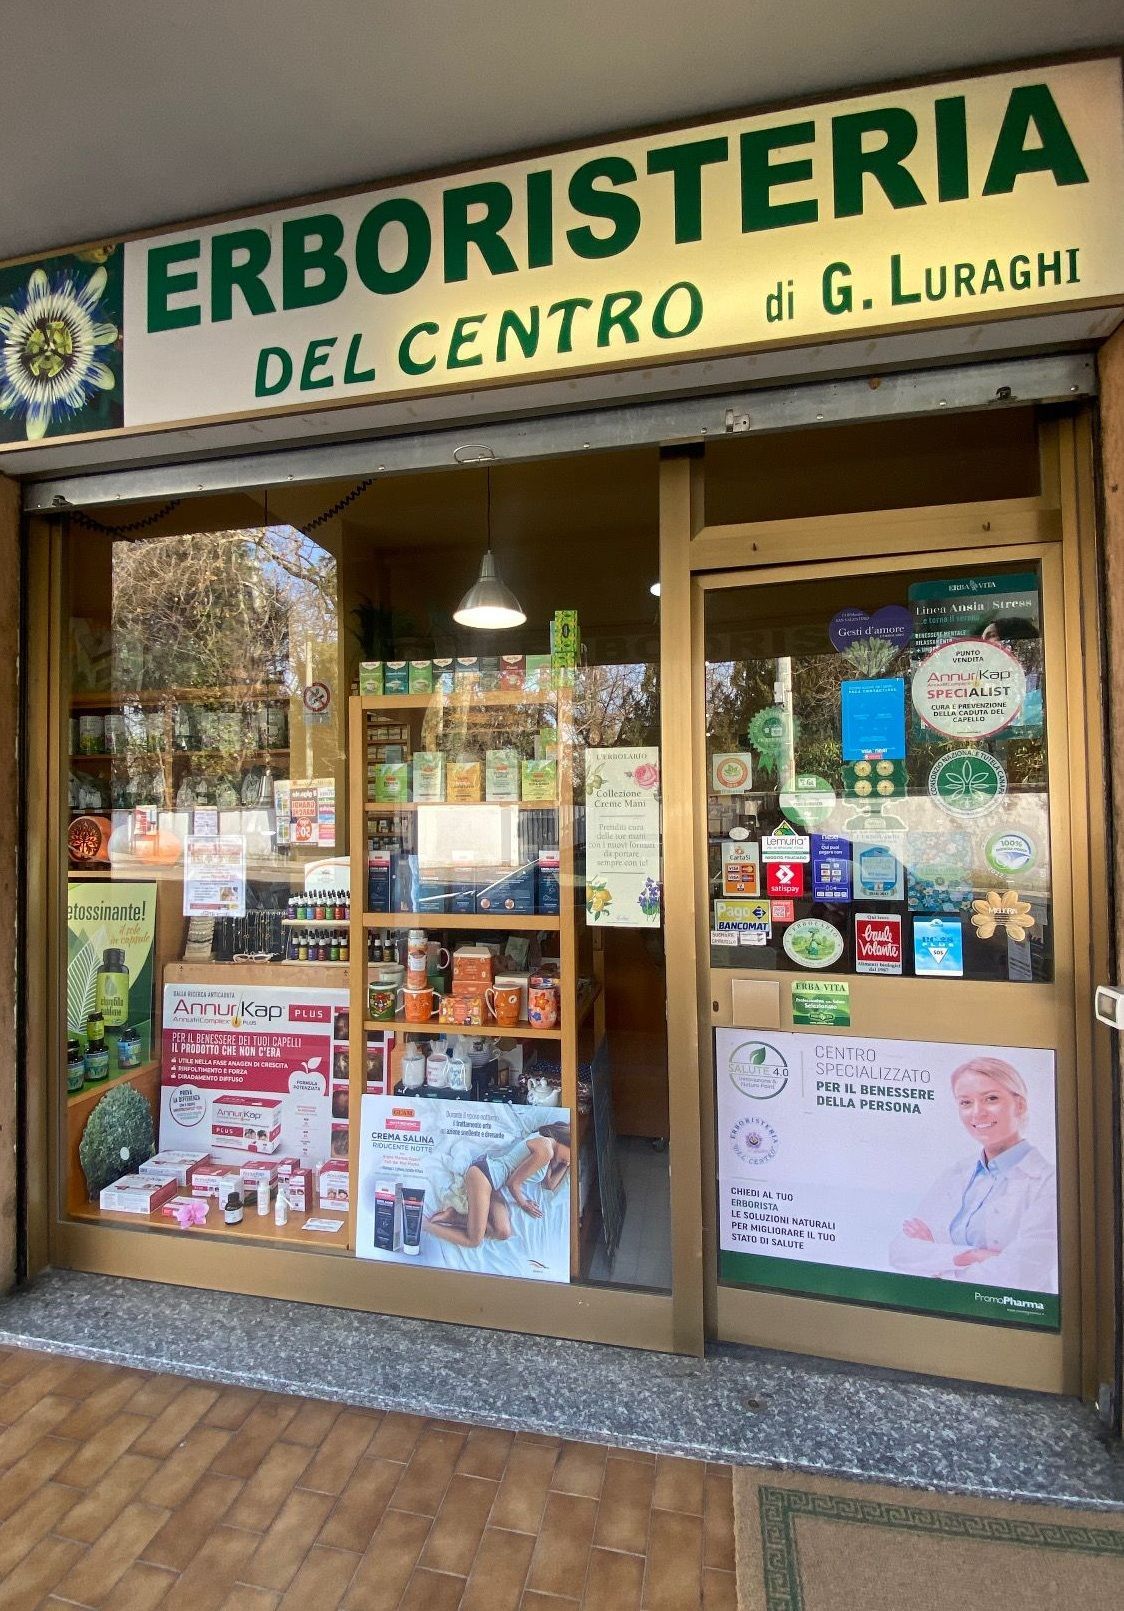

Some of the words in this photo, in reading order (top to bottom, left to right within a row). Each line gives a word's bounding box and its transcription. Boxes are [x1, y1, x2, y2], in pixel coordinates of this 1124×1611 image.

[147, 84, 1088, 332] ERBORISTERIA
[766, 283, 795, 323] di
[821, 262, 873, 316] G.
[891, 247, 1081, 307] LURAGHI
[256, 331, 375, 397] DEL
[399, 282, 703, 379] CENTRO
[916, 606, 946, 616] Linea
[950, 601, 984, 613] Ansia
[992, 599, 1032, 610] Stress
[838, 627, 862, 636] Gesti
[865, 626, 904, 635] d'amore
[928, 669, 1011, 682] AnnurKap
[927, 686, 1011, 699] SPECIALIST
[596, 790, 642, 798] Collezione
[594, 799, 622, 807] Creme
[625, 799, 646, 807] Mani
[766, 836, 804, 846] Lemuria
[770, 885, 799, 894] satispay
[717, 903, 750, 919] Pago
[718, 921, 768, 931] BANCOMAT
[858, 938, 900, 958] Volante
[796, 983, 820, 991] ERBA
[173, 998, 282, 1021] AnnurKap
[294, 1009, 323, 1018] PLUS
[172, 1032, 187, 1043] PER
[188, 1033, 194, 1043] IL
[196, 1033, 236, 1046] BENESSERE
[238, 1035, 251, 1046] DEI
[253, 1036, 270, 1047] TUOI
[272, 1036, 301, 1049] CAPELLI
[171, 1042, 179, 1052] IL
[180, 1043, 219, 1055] PRODOTTO
[221, 1045, 237, 1056] CHE
[239, 1045, 256, 1057] NON
[258, 1046, 281, 1058] C'ERA
[815, 1045, 876, 1062] CENTRO
[178, 1066, 223, 1074] RINFOLTIMENTO
[729, 1063, 770, 1076] SALUTE
[773, 1067, 789, 1077] 4.0
[815, 1062, 931, 1083] SPECIALIZZATO
[177, 1074, 218, 1082] DIRADAMENTO
[219, 1075, 244, 1083] DIFFUSO
[816, 1080, 841, 1093] PER
[845, 1083, 856, 1094] IL
[860, 1084, 935, 1101] BENESSERE
[816, 1096, 856, 1109] DELLA
[860, 1099, 921, 1114] PERSONA
[371, 1132, 401, 1141] CREMA
[403, 1134, 434, 1144] SALINA
[372, 1142, 409, 1151] RIDUCENTE
[410, 1145, 433, 1153] NOTTE
[731, 1187, 760, 1197] CHIEDI
[762, 1191, 773, 1199] AL
[776, 1193, 793, 1201] TUO
[731, 1199, 778, 1211] ERBORISTA
[731, 1210, 741, 1218] LE
[743, 1211, 789, 1224] SOLUZIONI
[792, 1218, 836, 1230] NATURALI
[732, 1221, 748, 1230] PER
[750, 1224, 804, 1238] MIGLIORARE
[807, 1231, 815, 1239] IL
[818, 1232, 836, 1242] TUO
[731, 1233, 757, 1243] STATO
[760, 1236, 769, 1244] DI
[771, 1239, 804, 1249] SALUTE
[974, 1291, 1045, 1310] PromoPharma
